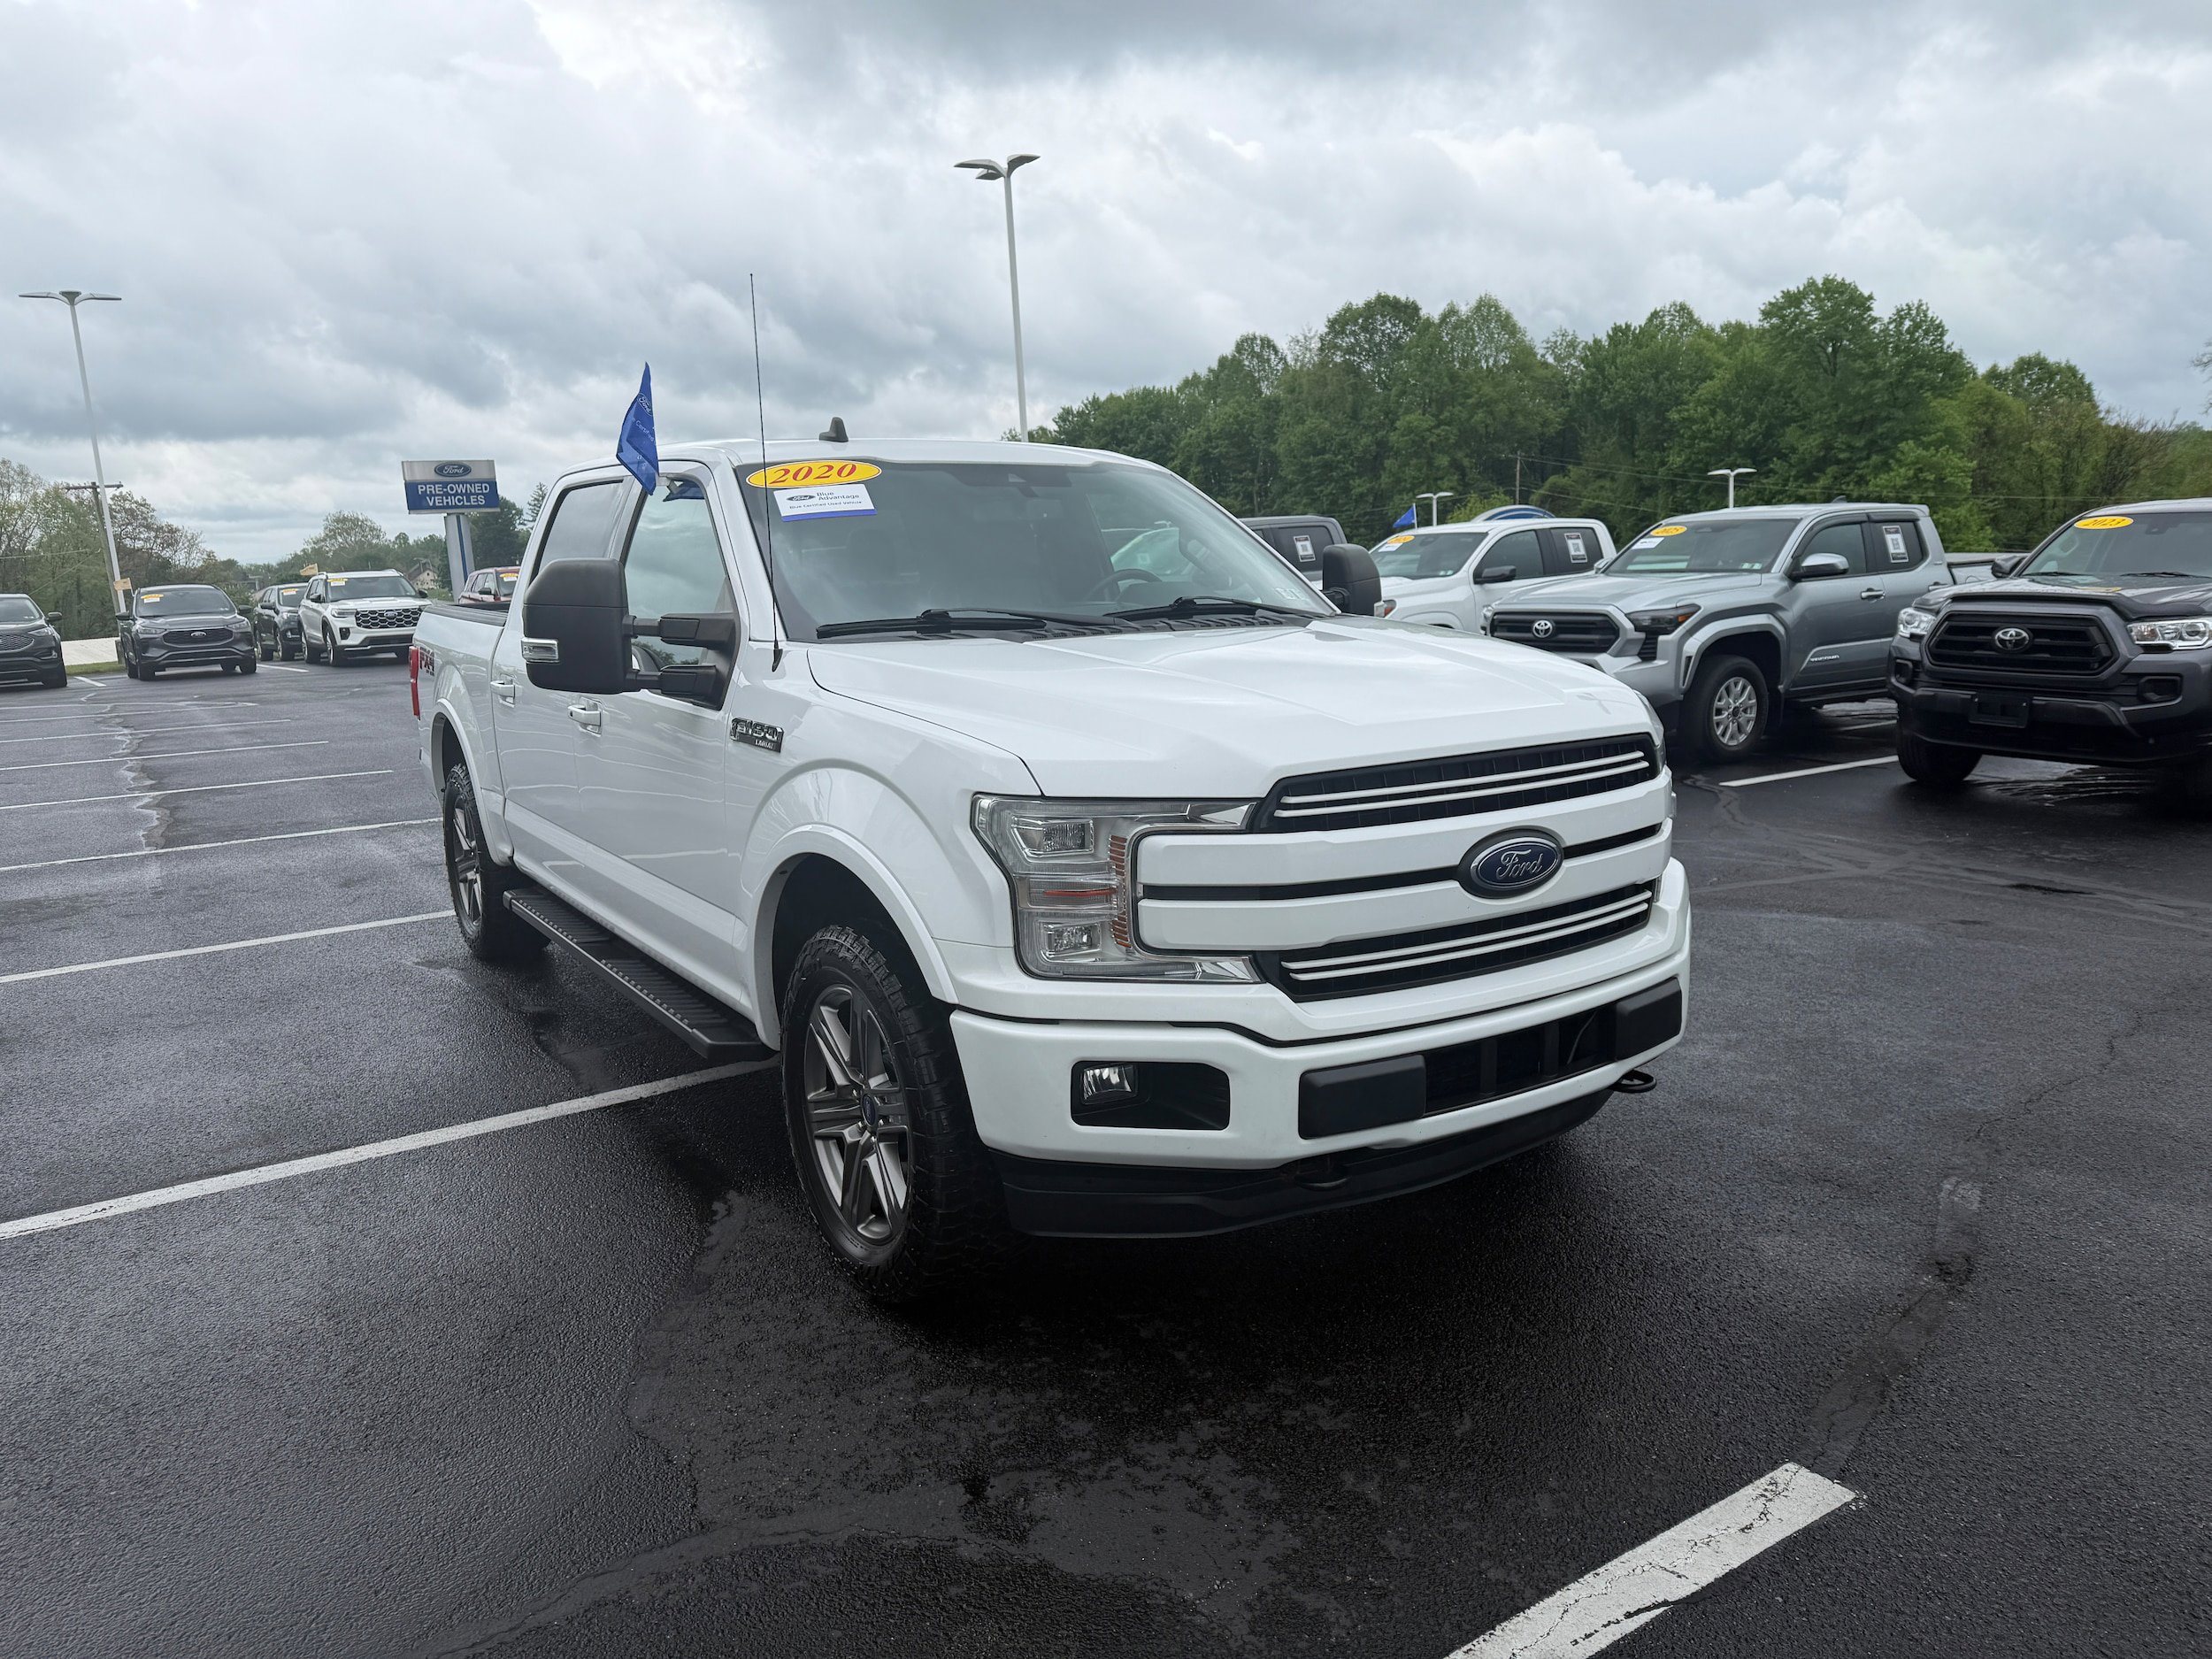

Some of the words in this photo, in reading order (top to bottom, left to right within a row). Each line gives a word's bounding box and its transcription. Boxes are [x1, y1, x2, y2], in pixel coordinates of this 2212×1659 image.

[639, 396, 651, 413] Ford
[442, 465, 465, 474] Ford
[769, 464, 856, 484] 2020
[418, 483, 489, 495] PRE-OWNED
[426, 495, 486, 506] VEHICLES
[419, 646, 434, 672] FX4
[1497, 849, 1543, 879] Ford
